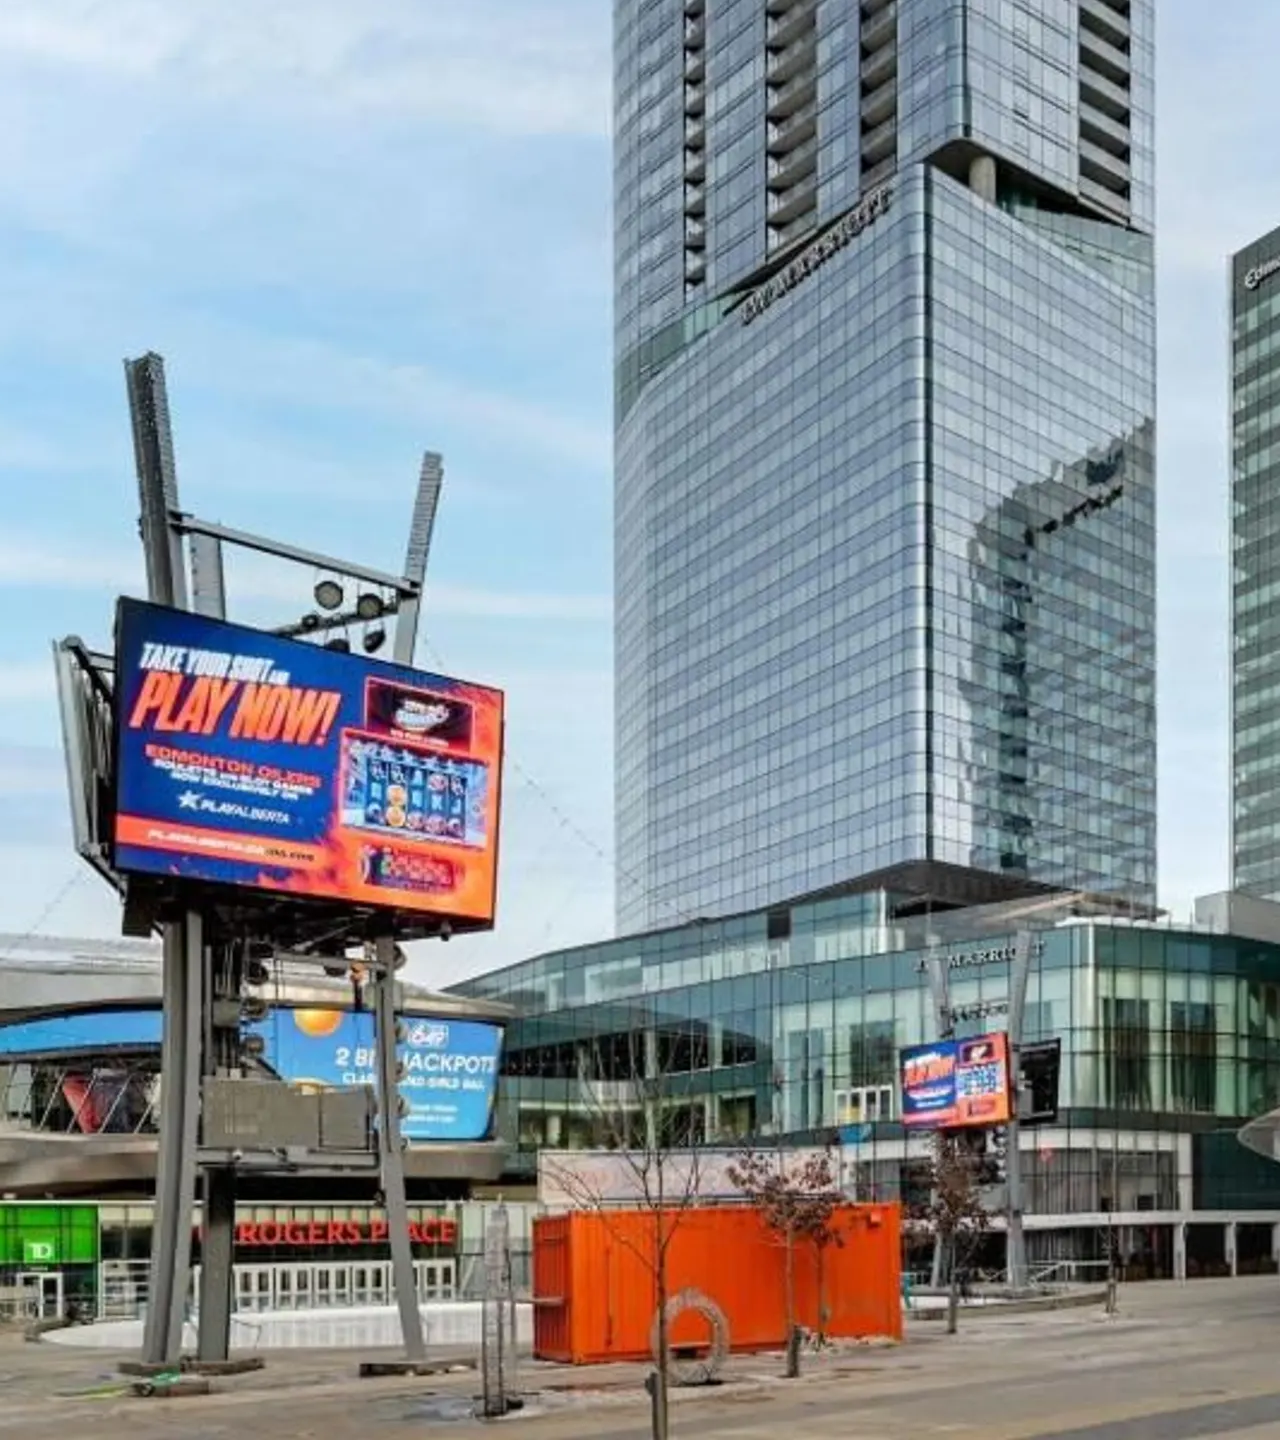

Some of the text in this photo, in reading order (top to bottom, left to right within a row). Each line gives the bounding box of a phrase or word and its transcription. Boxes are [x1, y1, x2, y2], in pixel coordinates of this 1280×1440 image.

[139, 642, 186, 672] TAKE
[186, 647, 231, 678] YOUR
[228, 654, 275, 683] SHOT
[128, 671, 238, 735] PLAY
[228, 683, 341, 746] NOW!
[145, 744, 255, 773] EDMONTON
[200, 798, 291, 825] PLAYALBERTA
[335, 1047, 350, 1067] 2
[237, 1217, 458, 1244] ROGERS PACE
[29, 1242, 54, 1259] TD
